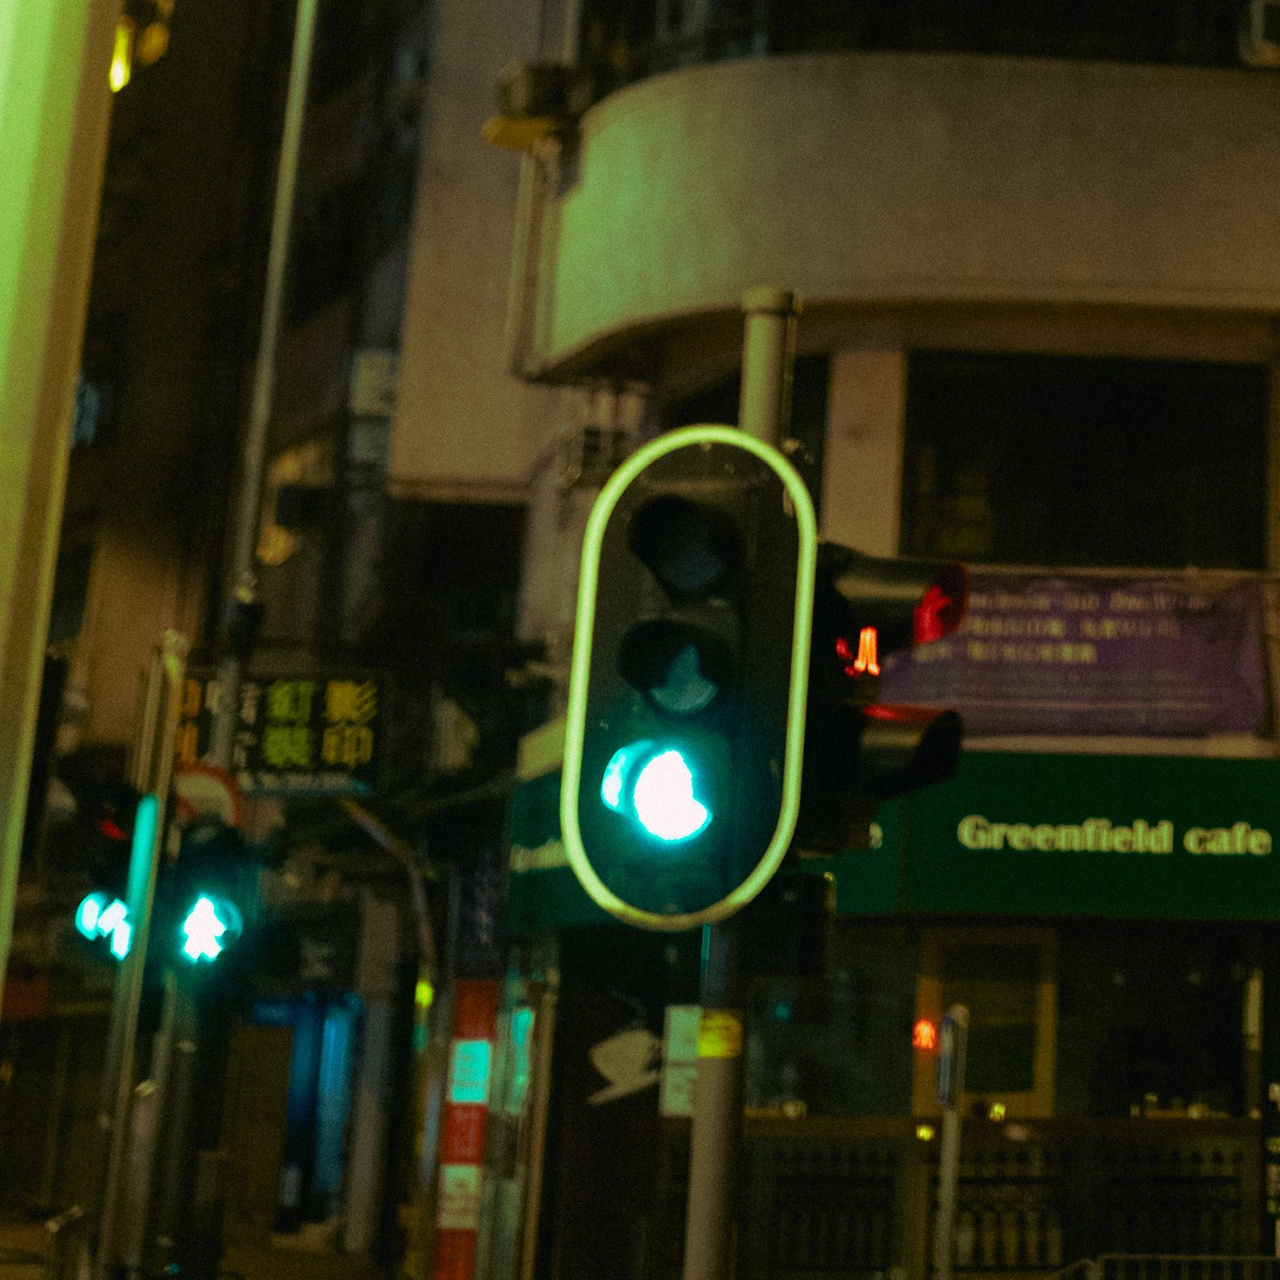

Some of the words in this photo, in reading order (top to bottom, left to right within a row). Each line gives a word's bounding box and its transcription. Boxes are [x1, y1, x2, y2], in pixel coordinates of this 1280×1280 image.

[323, 679, 379, 769] 影印
[956, 814, 1173, 854] Greenfield
[1182, 821, 1272, 856] cafe
